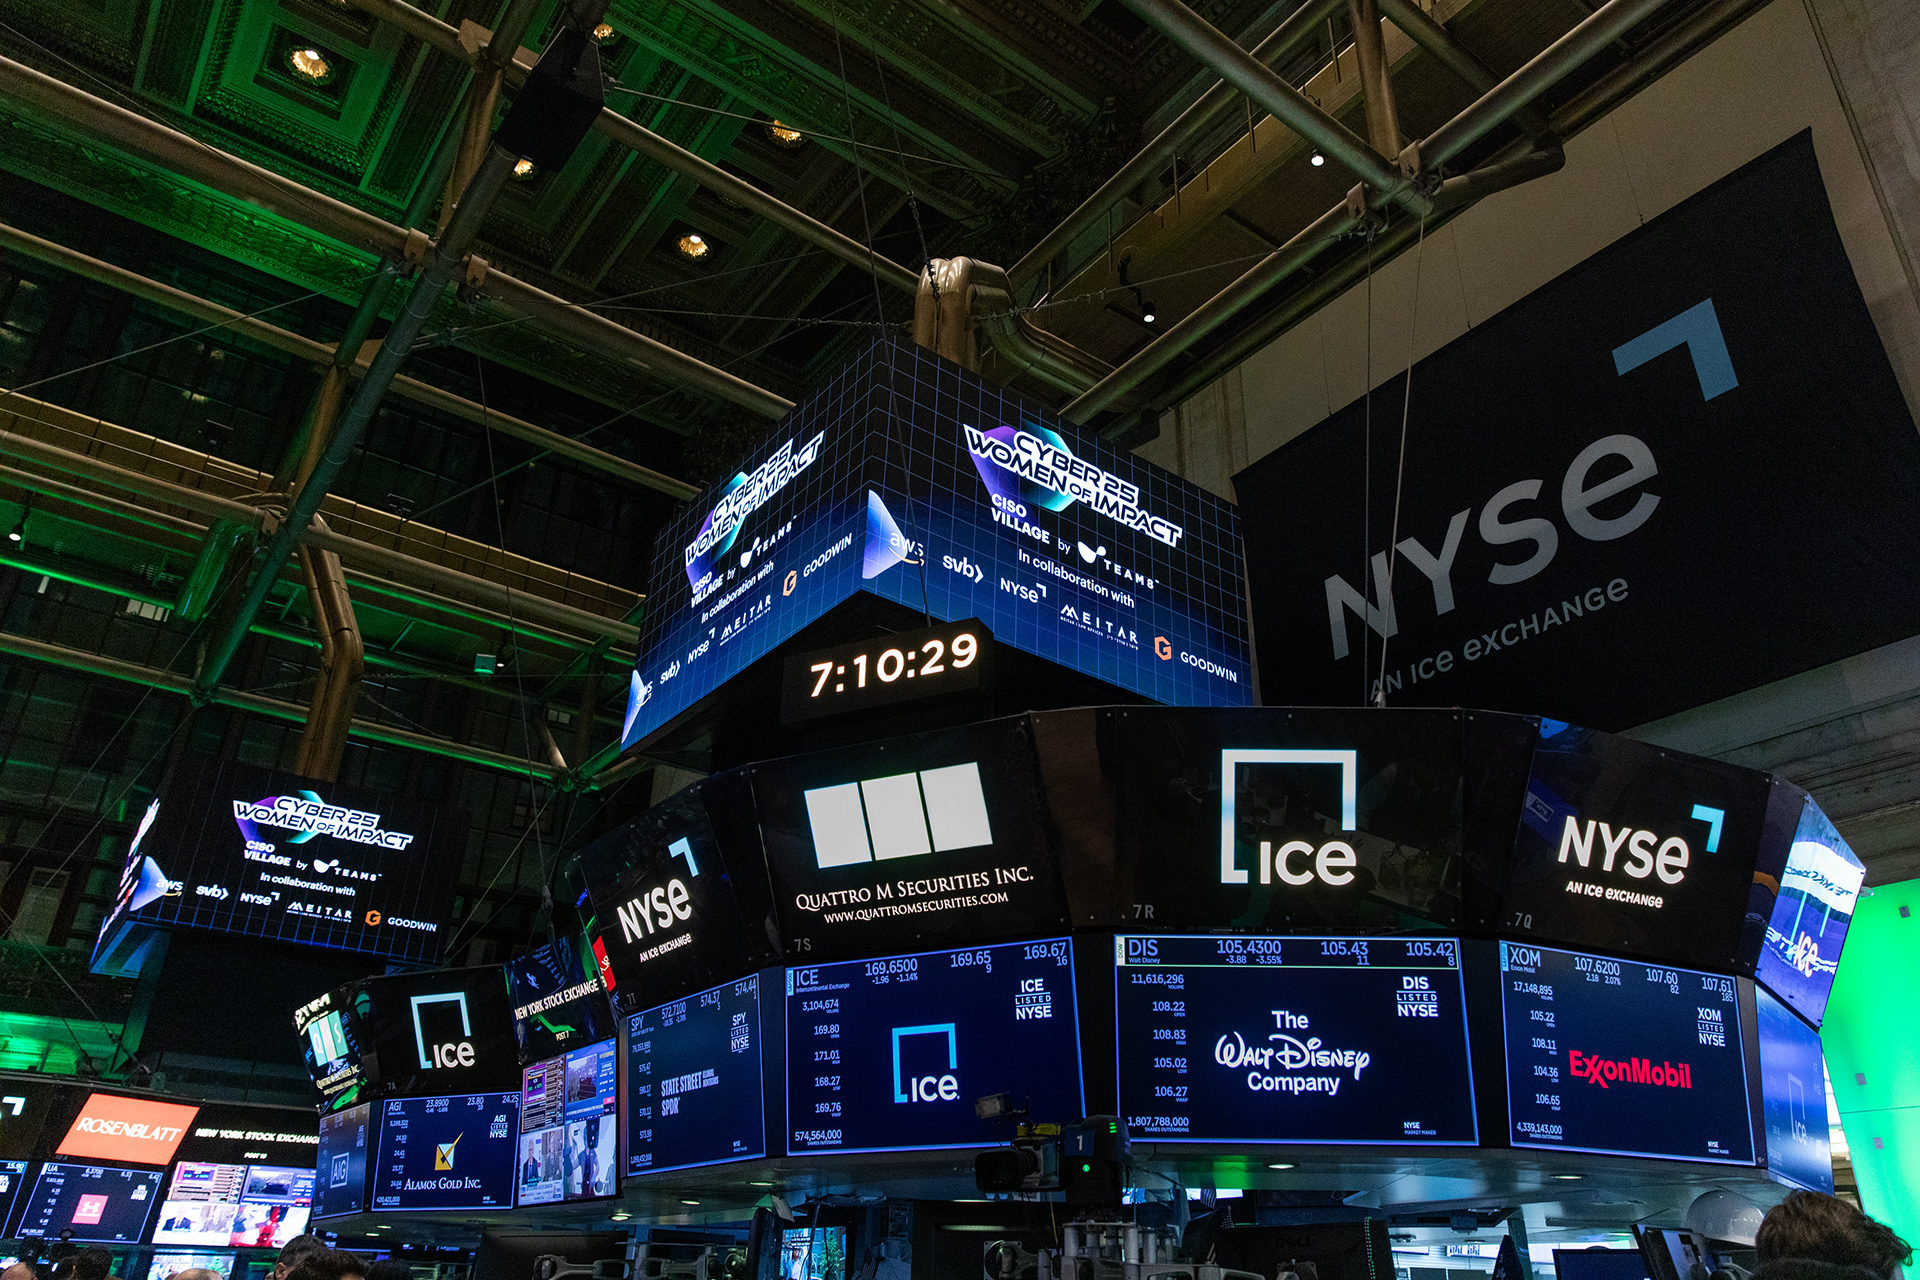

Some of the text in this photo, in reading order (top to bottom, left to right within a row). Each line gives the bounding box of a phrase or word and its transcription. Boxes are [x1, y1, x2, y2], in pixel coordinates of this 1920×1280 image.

[1014, 432, 1138, 505] CYBER 25
[713, 441, 792, 522] CYBER 25
[965, 427, 1182, 546] WOMEN OF IMPACT
[686, 433, 824, 567] WOMEN OF IMPACT
[992, 493, 1027, 517] CISO
[991, 507, 1050, 545] VILLAGE
[1057, 538, 1071, 554] by
[889, 532, 924, 557] aws
[803, 533, 853, 577] GOODWIN
[1018, 548, 1135, 608] In collaboration with
[720, 595, 771, 640] MEITAR
[1060, 604, 1138, 645] MEITAR
[810, 633, 978, 698] 7:10:29
[1180, 651, 1238, 684] GOODWIN
[1370, 669, 1402, 701] AN
[275, 797, 379, 828] CYBER 25
[234, 801, 412, 849] WOMEN OF IMPACT
[245, 840, 275, 853] CISO
[244, 849, 292, 867] VILLAGE
[296, 859, 307, 870] by
[156, 879, 184, 891] aws
[260, 872, 356, 896] In collaboration with
[1566, 881, 1583, 895] AN
[876, 883, 893, 901] M
[287, 901, 352, 919] MEITAR
[824, 892, 1009, 924] WWW.QUATTROMSECURITIES.COM
[1133, 904, 1154, 919] 7R
[387, 917, 438, 932] GOODWIN
[1515, 913, 1532, 929] 7Q
[794, 938, 811, 952] 7S
[1128, 939, 1454, 956] DIS 105.4300 105.43 105.42
[796, 942, 1066, 987] ICE 169.6500 169.65 169.67
[1142, 957, 1160, 965] Disney
[1225, 955, 1247, 964] -3.88
[1256, 955, 1282, 964] -3.55%
[1357, 955, 1369, 965] 11
[1448, 956, 1455, 966] 8
[872, 975, 889, 985] -1.96
[897, 972, 918, 983] -1.14%
[986, 963, 992, 973] 9
[1056, 955, 1068, 966] 16
[1509, 946, 1732, 993] XOM 107.6200 107.60 107.61
[1021, 978, 1044, 993] ICE
[1131, 974, 1184, 986] 11,616,296
[1402, 976, 1430, 990] DIS
[1523, 966, 1535, 974] Mobil
[1586, 973, 1599, 982] 2.18
[1605, 976, 1621, 986] 2.07%
[1670, 984, 1679, 994] 82
[1513, 981, 1552, 995] 17,148,895
[514, 978, 599, 1020] NEW YORK STOCK EXCHANGE
[631, 1015, 644, 1031] SPY
[700, 990, 720, 1007] 574.37
[735, 978, 756, 996] 574.44
[802, 999, 839, 1012] 3,104,674
[1015, 995, 1051, 1004] LISTED
[1152, 1001, 1185, 1011] 108.22
[1016, 1005, 1052, 1020] NYSE
[1397, 1004, 1439, 1017] NYSE
[1530, 1010, 1555, 1022] 105.22
[1697, 1006, 1722, 1022] XOM
[732, 1011, 746, 1026] SPY
[1271, 1010, 1309, 1029] The
[731, 1026, 749, 1037] LISTED
[814, 1024, 840, 1035] 169.80
[1153, 1029, 1186, 1040] 108.83
[1697, 1023, 1724, 1032] LISTED
[555, 1031, 566, 1041] POST
[731, 1035, 749, 1050] NYSE
[1532, 1037, 1557, 1050] 108.11
[1699, 1033, 1726, 1047] NYSE
[814, 1050, 840, 1061] 171.01
[1154, 1057, 1187, 1068] 105.02
[1533, 1065, 1558, 1078] 104.36
[1568, 1050, 1691, 1089] ExxonMobil
[661, 1071, 702, 1097] STATE STREET
[814, 1076, 840, 1087] 168.27
[1248, 1071, 1340, 1096] Company
[1155, 1086, 1188, 1097] 106.27
[1535, 1093, 1560, 1105] 106.65
[388, 1101, 402, 1111] AGI
[502, 1095, 519, 1104] 24.25
[815, 1102, 841, 1113] 169.76
[493, 1114, 506, 1123] AGI
[1128, 1116, 1189, 1127] 1,807,788,000
[1404, 1121, 1420, 1129] NYSE
[76, 1117, 182, 1142] ROSENBLATT
[195, 1128, 219, 1137] NEW
[219, 1129, 245, 1139] YORK
[245, 1131, 276, 1142] STOCK
[489, 1130, 507, 1138] NYSE
[795, 1129, 842, 1141] 574,564,000
[1516, 1121, 1562, 1134] 4,339,143,000
[1076, 1134, 1083, 1151] 1
[332, 1160, 346, 1181] AIG
[404, 1178, 436, 1190] ALAMOS
[438, 1177, 462, 1189] GOLD
